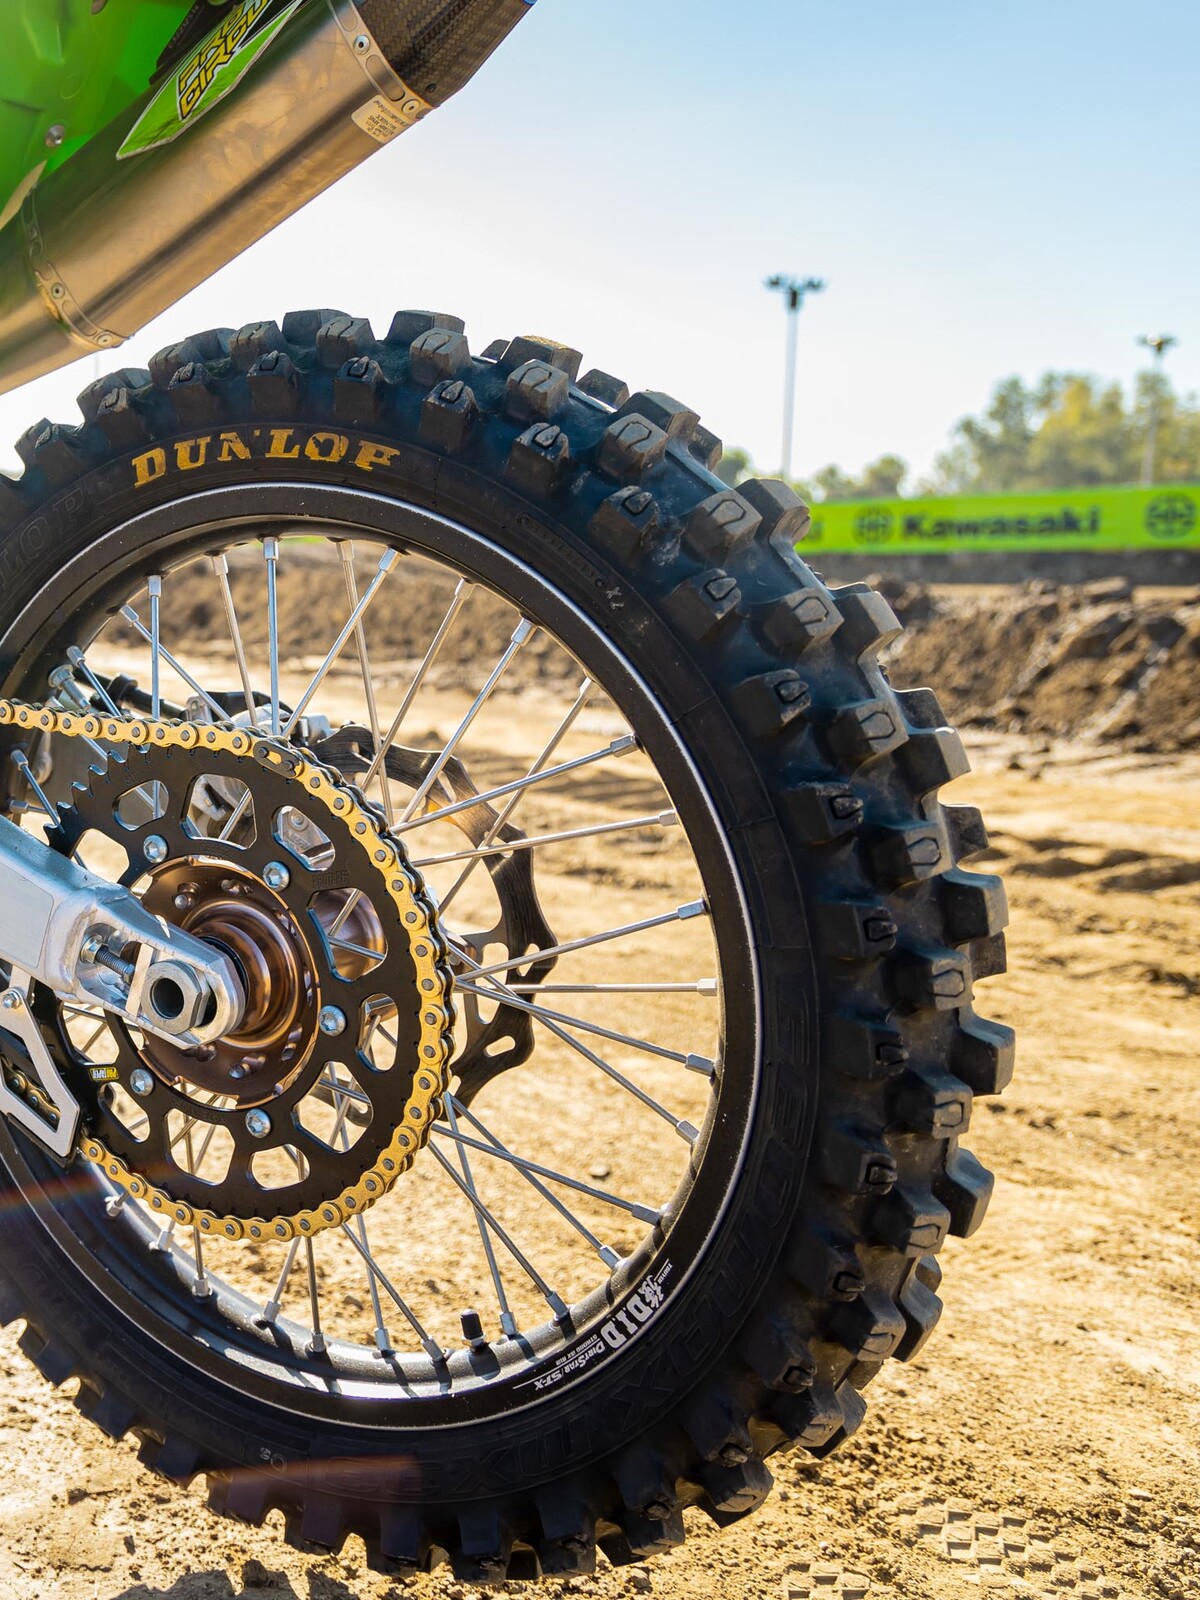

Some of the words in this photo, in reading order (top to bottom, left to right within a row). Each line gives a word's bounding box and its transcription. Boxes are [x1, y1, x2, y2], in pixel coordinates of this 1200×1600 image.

[179, 0, 246, 96] PRO
[179, 0, 269, 120] CIRCU
[131, 428, 401, 489] DUNLOP
[903, 506, 1102, 541] Kawasaki
[600, 1293, 654, 1350] D.I.D
